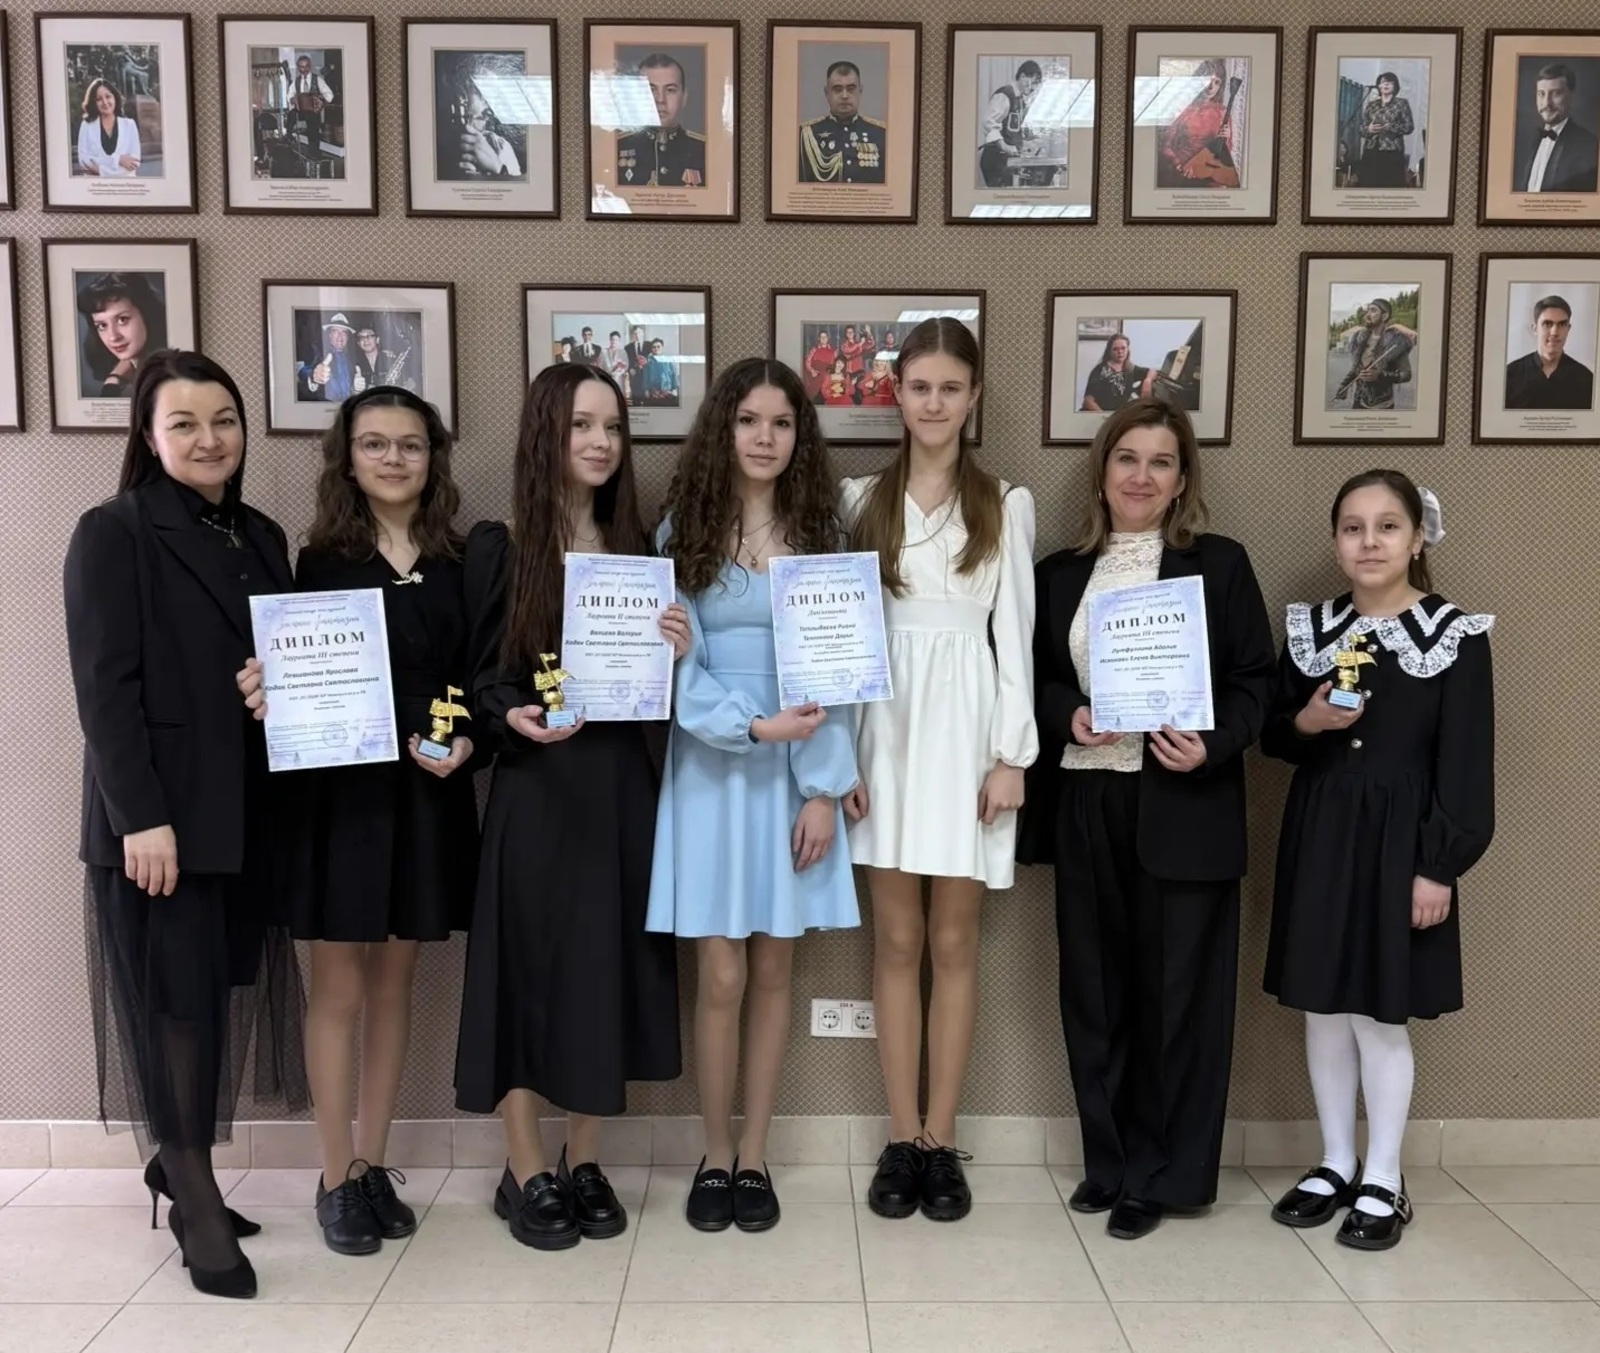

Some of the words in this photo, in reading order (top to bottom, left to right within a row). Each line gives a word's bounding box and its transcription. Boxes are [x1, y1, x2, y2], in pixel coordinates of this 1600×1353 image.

[576, 595, 659, 609] ДИПЛОМ
[786, 591, 866, 608] ДИПЛОМ
[1102, 613, 1186, 632] ДИПЛОМ
[270, 631, 365, 651] ДИПЛОМ
[280, 653, 316, 663] Лауреата
[329, 650, 360, 658] степени
[287, 681, 323, 690] Светлана
